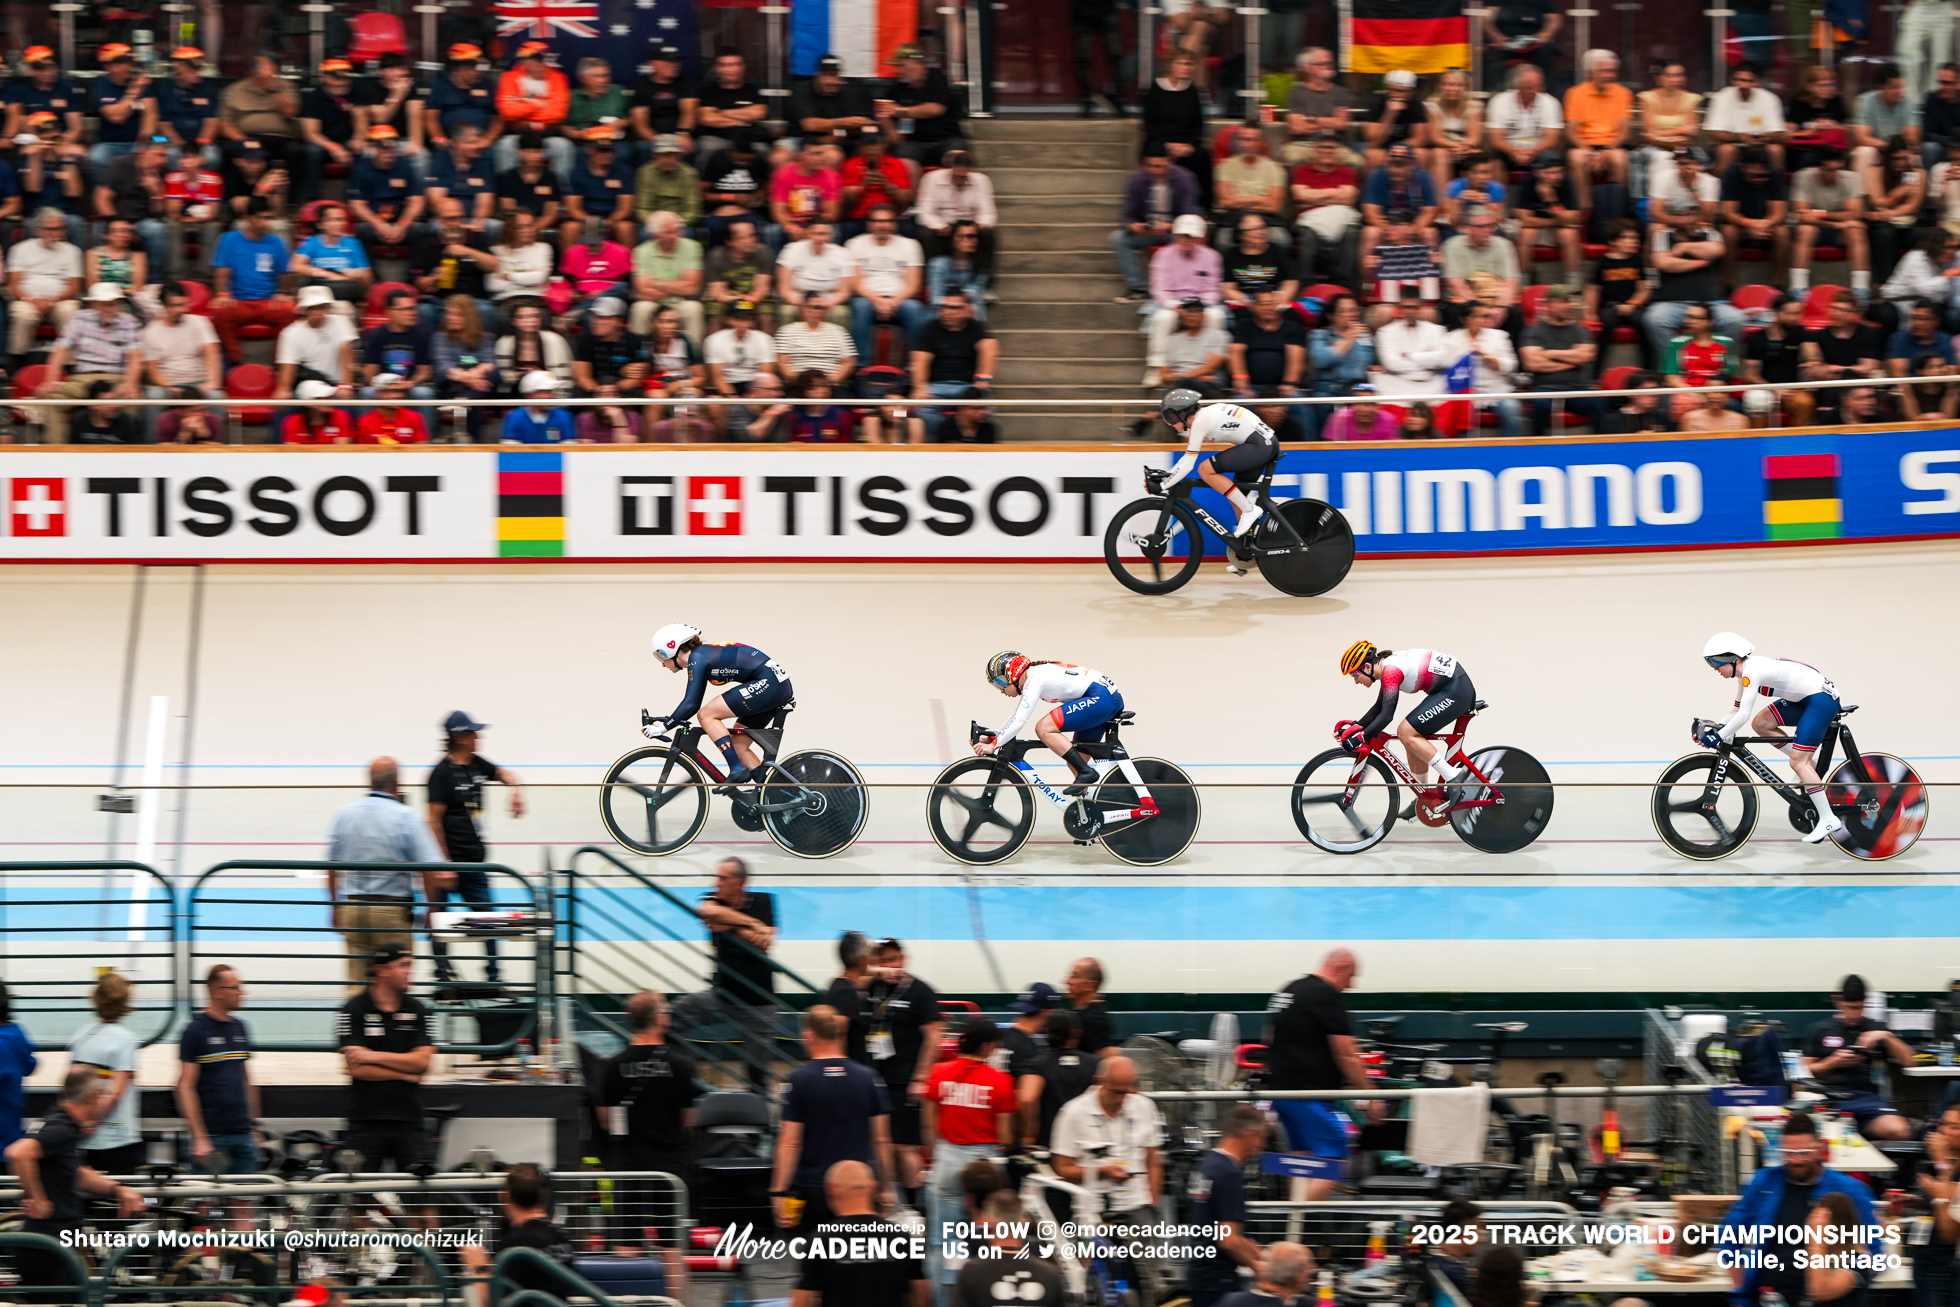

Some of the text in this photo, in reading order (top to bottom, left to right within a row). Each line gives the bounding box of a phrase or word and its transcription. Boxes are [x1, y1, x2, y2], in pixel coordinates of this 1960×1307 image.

[85, 475, 443, 538] TISSOT
[761, 475, 1118, 538] TISSOT
[1194, 508, 1229, 536] FES
[1066, 696, 1100, 714] JAPAN
[1417, 697, 1455, 723] SLOVAKIA
[1379, 749, 1425, 794] PARDUS
[1711, 759, 1729, 796] LOTUS
